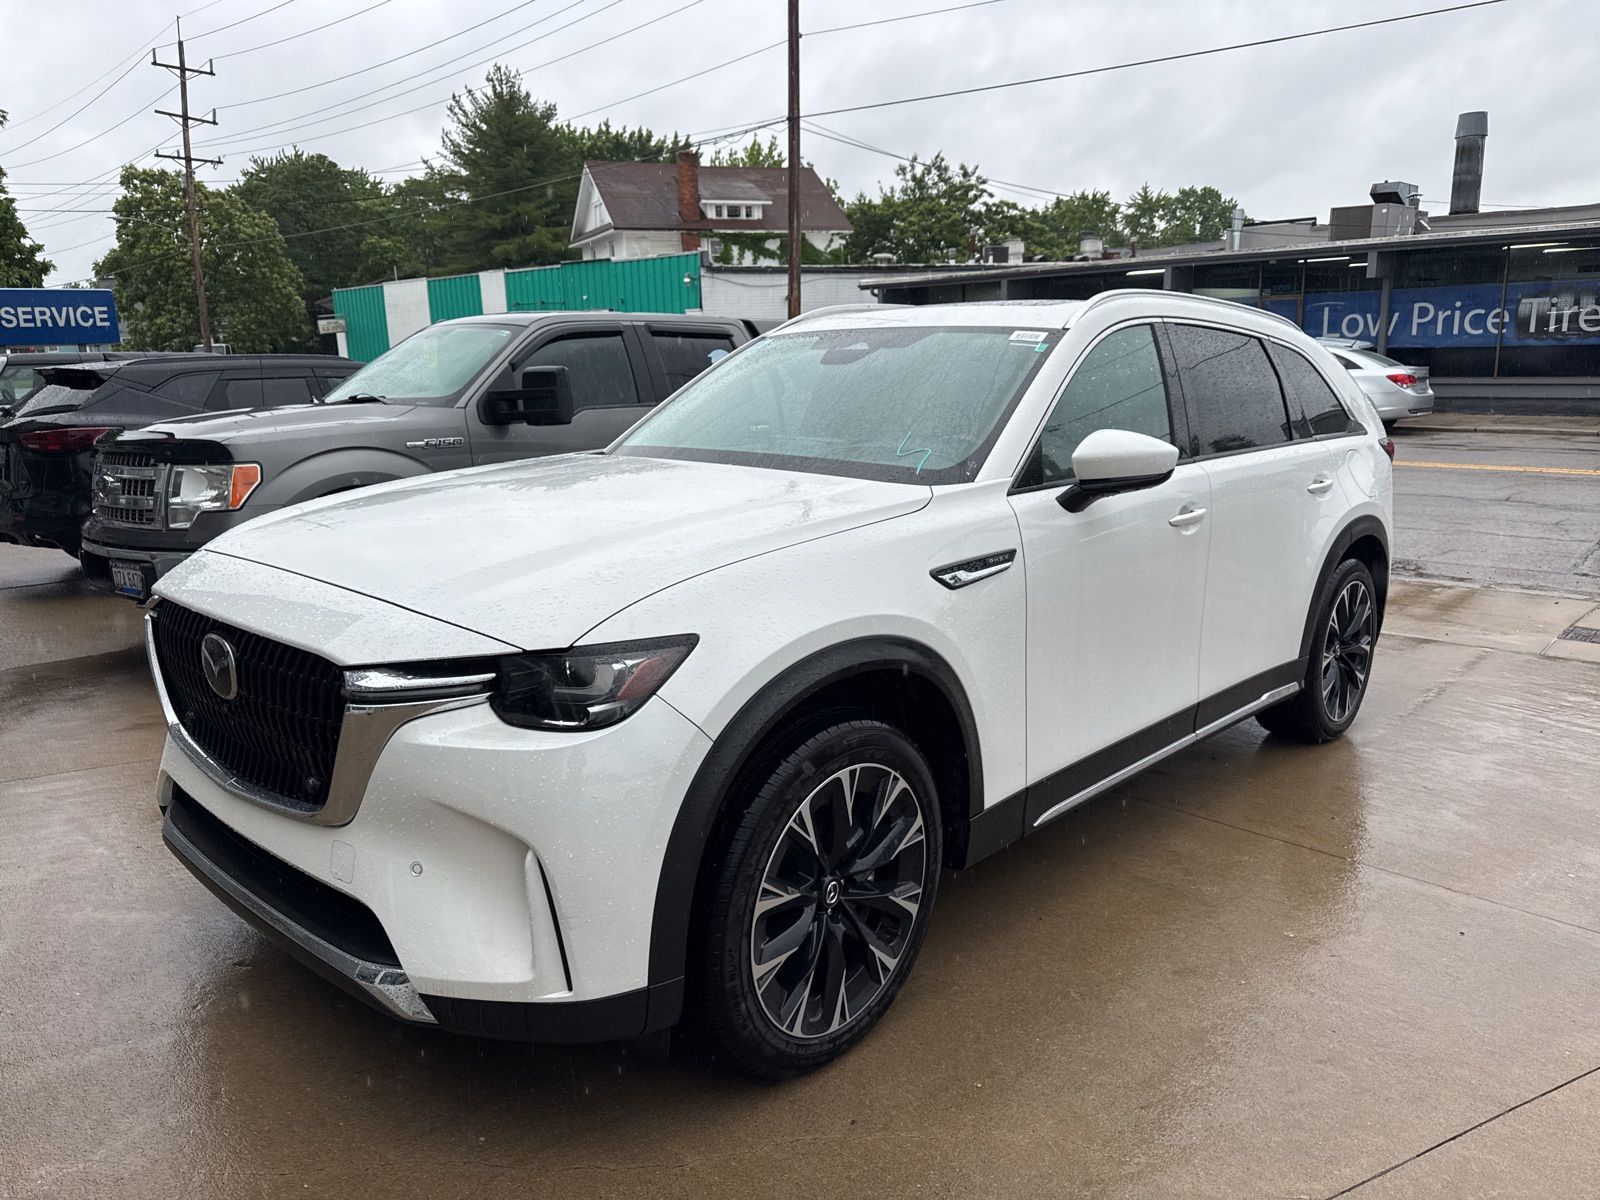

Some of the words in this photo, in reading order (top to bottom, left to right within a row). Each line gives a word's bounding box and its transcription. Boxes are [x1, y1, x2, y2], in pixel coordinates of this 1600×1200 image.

[0, 306, 110, 328] SERVICE
[1322, 307, 1399, 337] Low
[1411, 301, 1510, 335] Price
[1521, 296, 1600, 333] Tire
